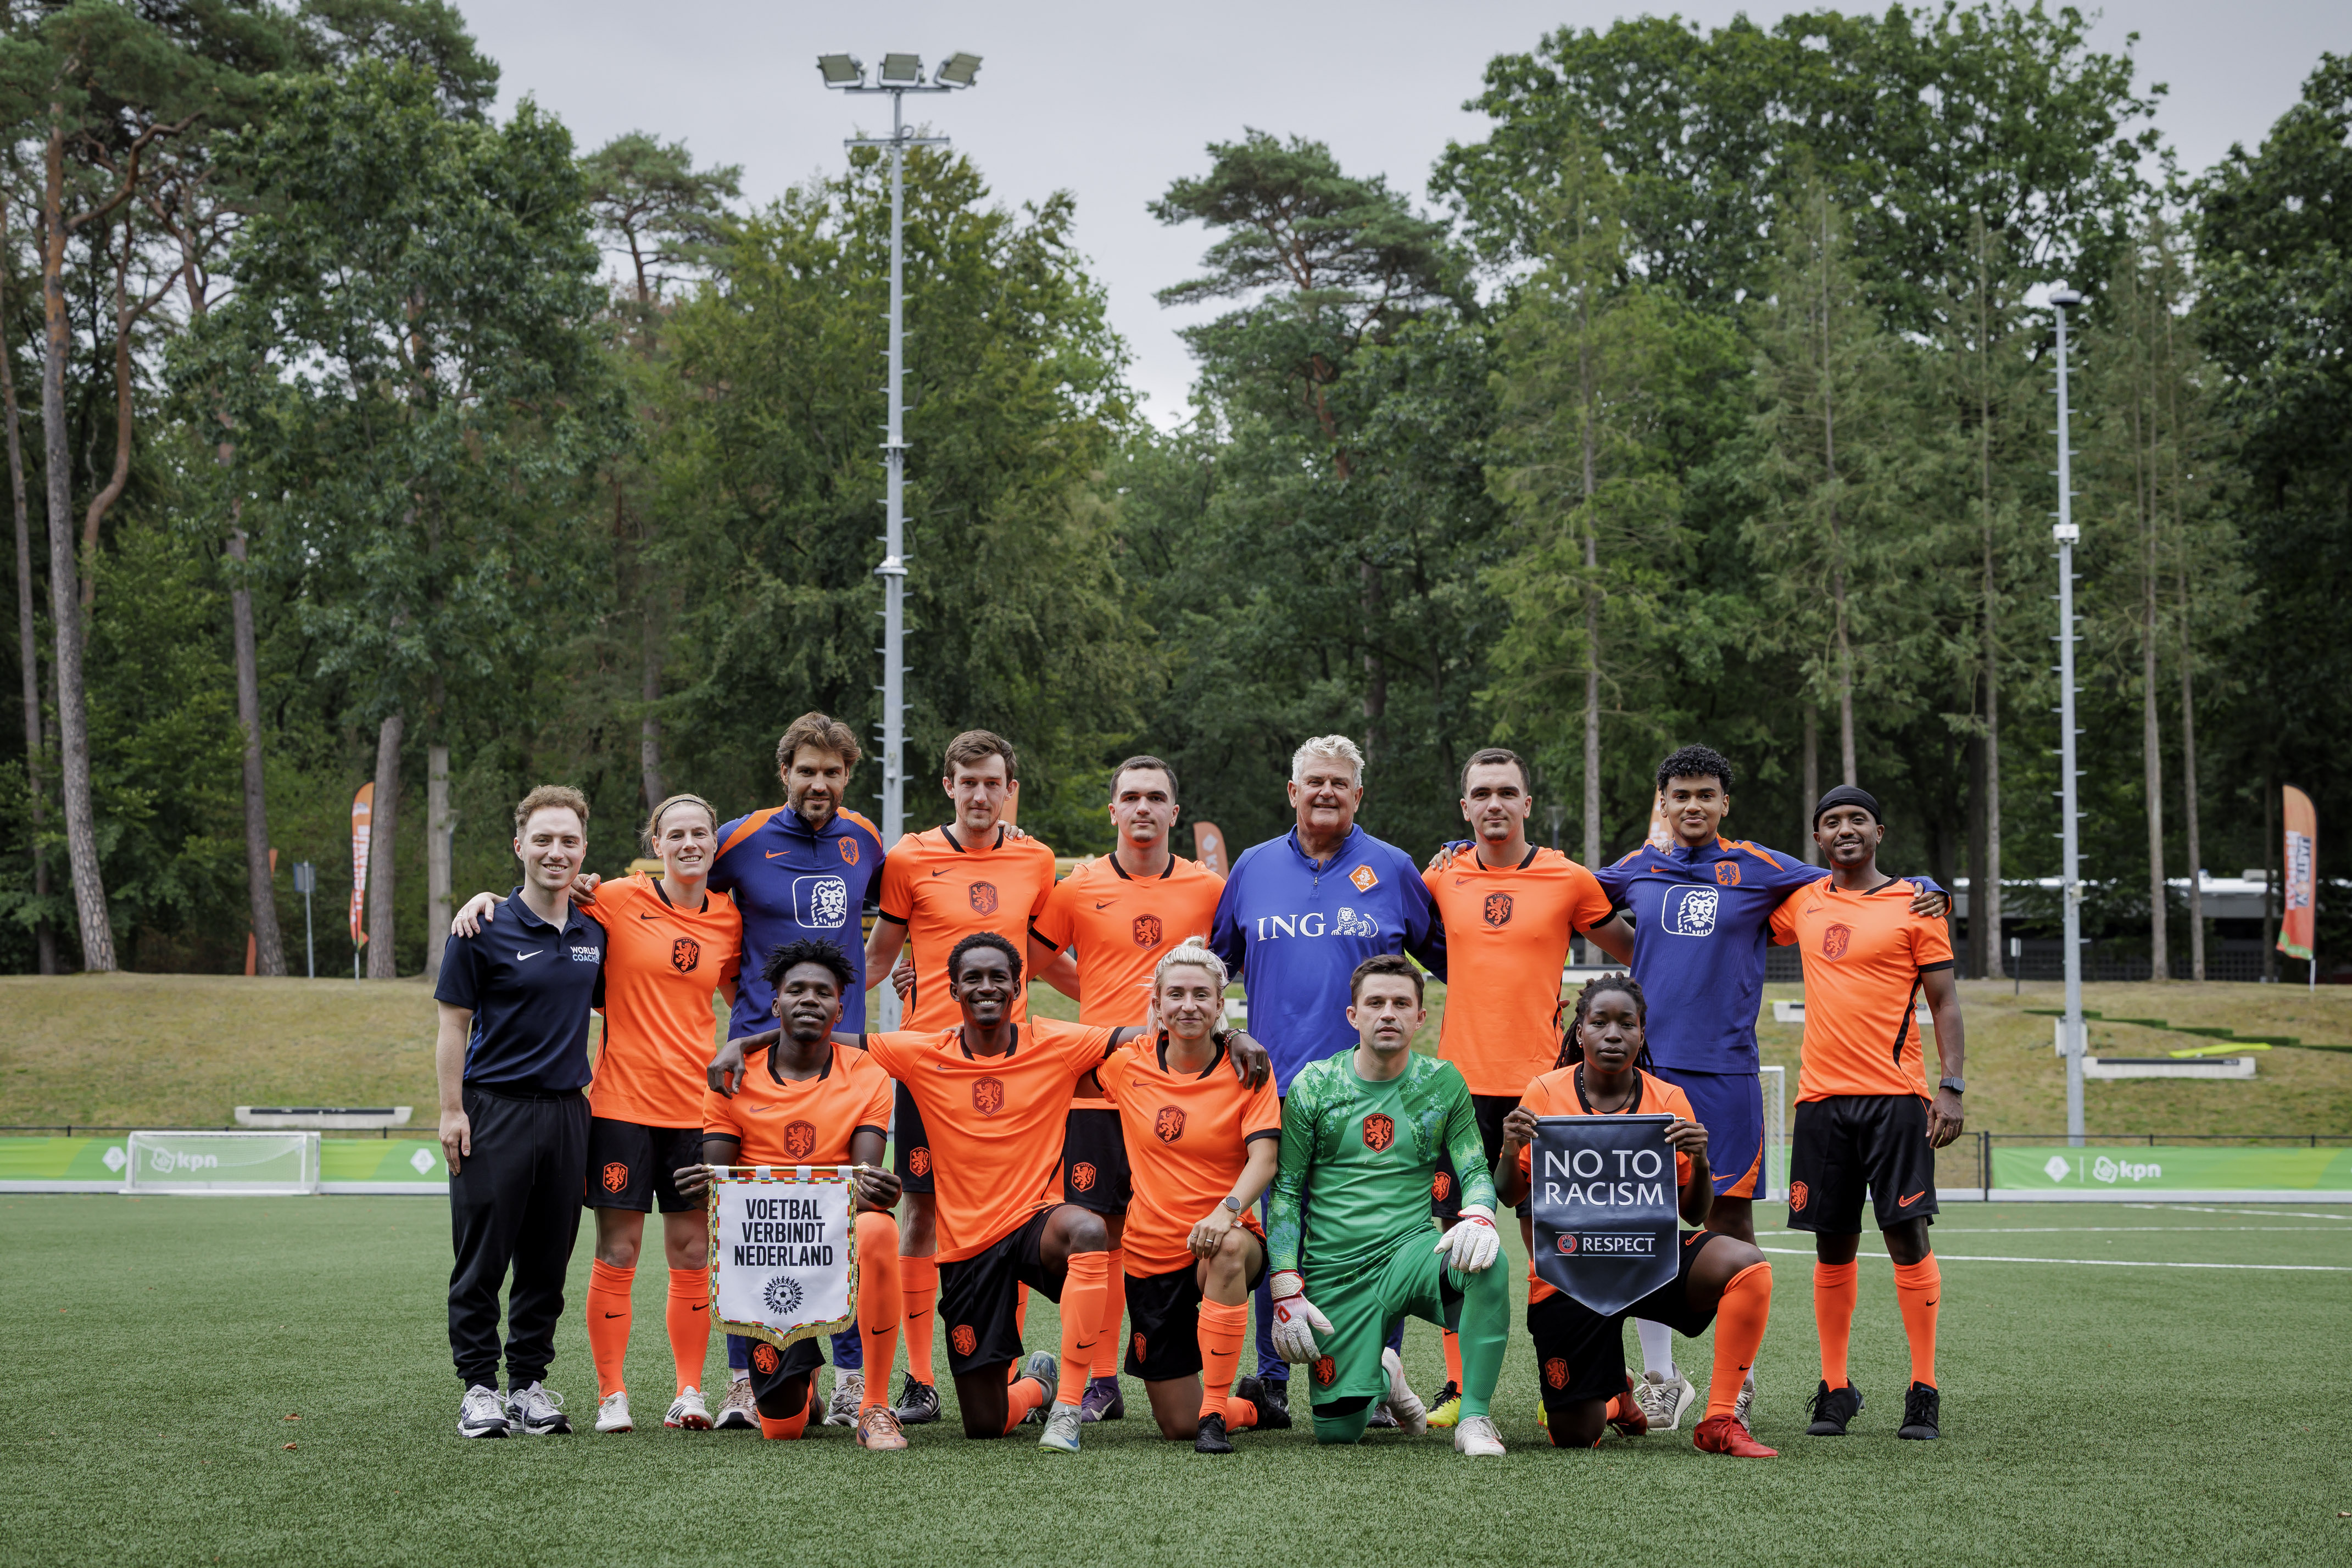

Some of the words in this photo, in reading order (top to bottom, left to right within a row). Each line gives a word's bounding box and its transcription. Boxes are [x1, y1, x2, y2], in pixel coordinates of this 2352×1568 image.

[1257, 912, 1327, 941] ING
[570, 946, 595, 955] WORLD
[177, 1151, 218, 1172] kpn
[1545, 1150, 1603, 1178] NO
[1612, 1150, 1662, 1178] TO
[2120, 1160, 2161, 1181] kpn
[1545, 1182, 1664, 1206] RACISM
[745, 1199, 822, 1220] VOETBAL
[742, 1222, 826, 1243] VERBINDT
[1583, 1237, 1655, 1252] RESPECT
[734, 1245, 833, 1266] NEDERLAND
